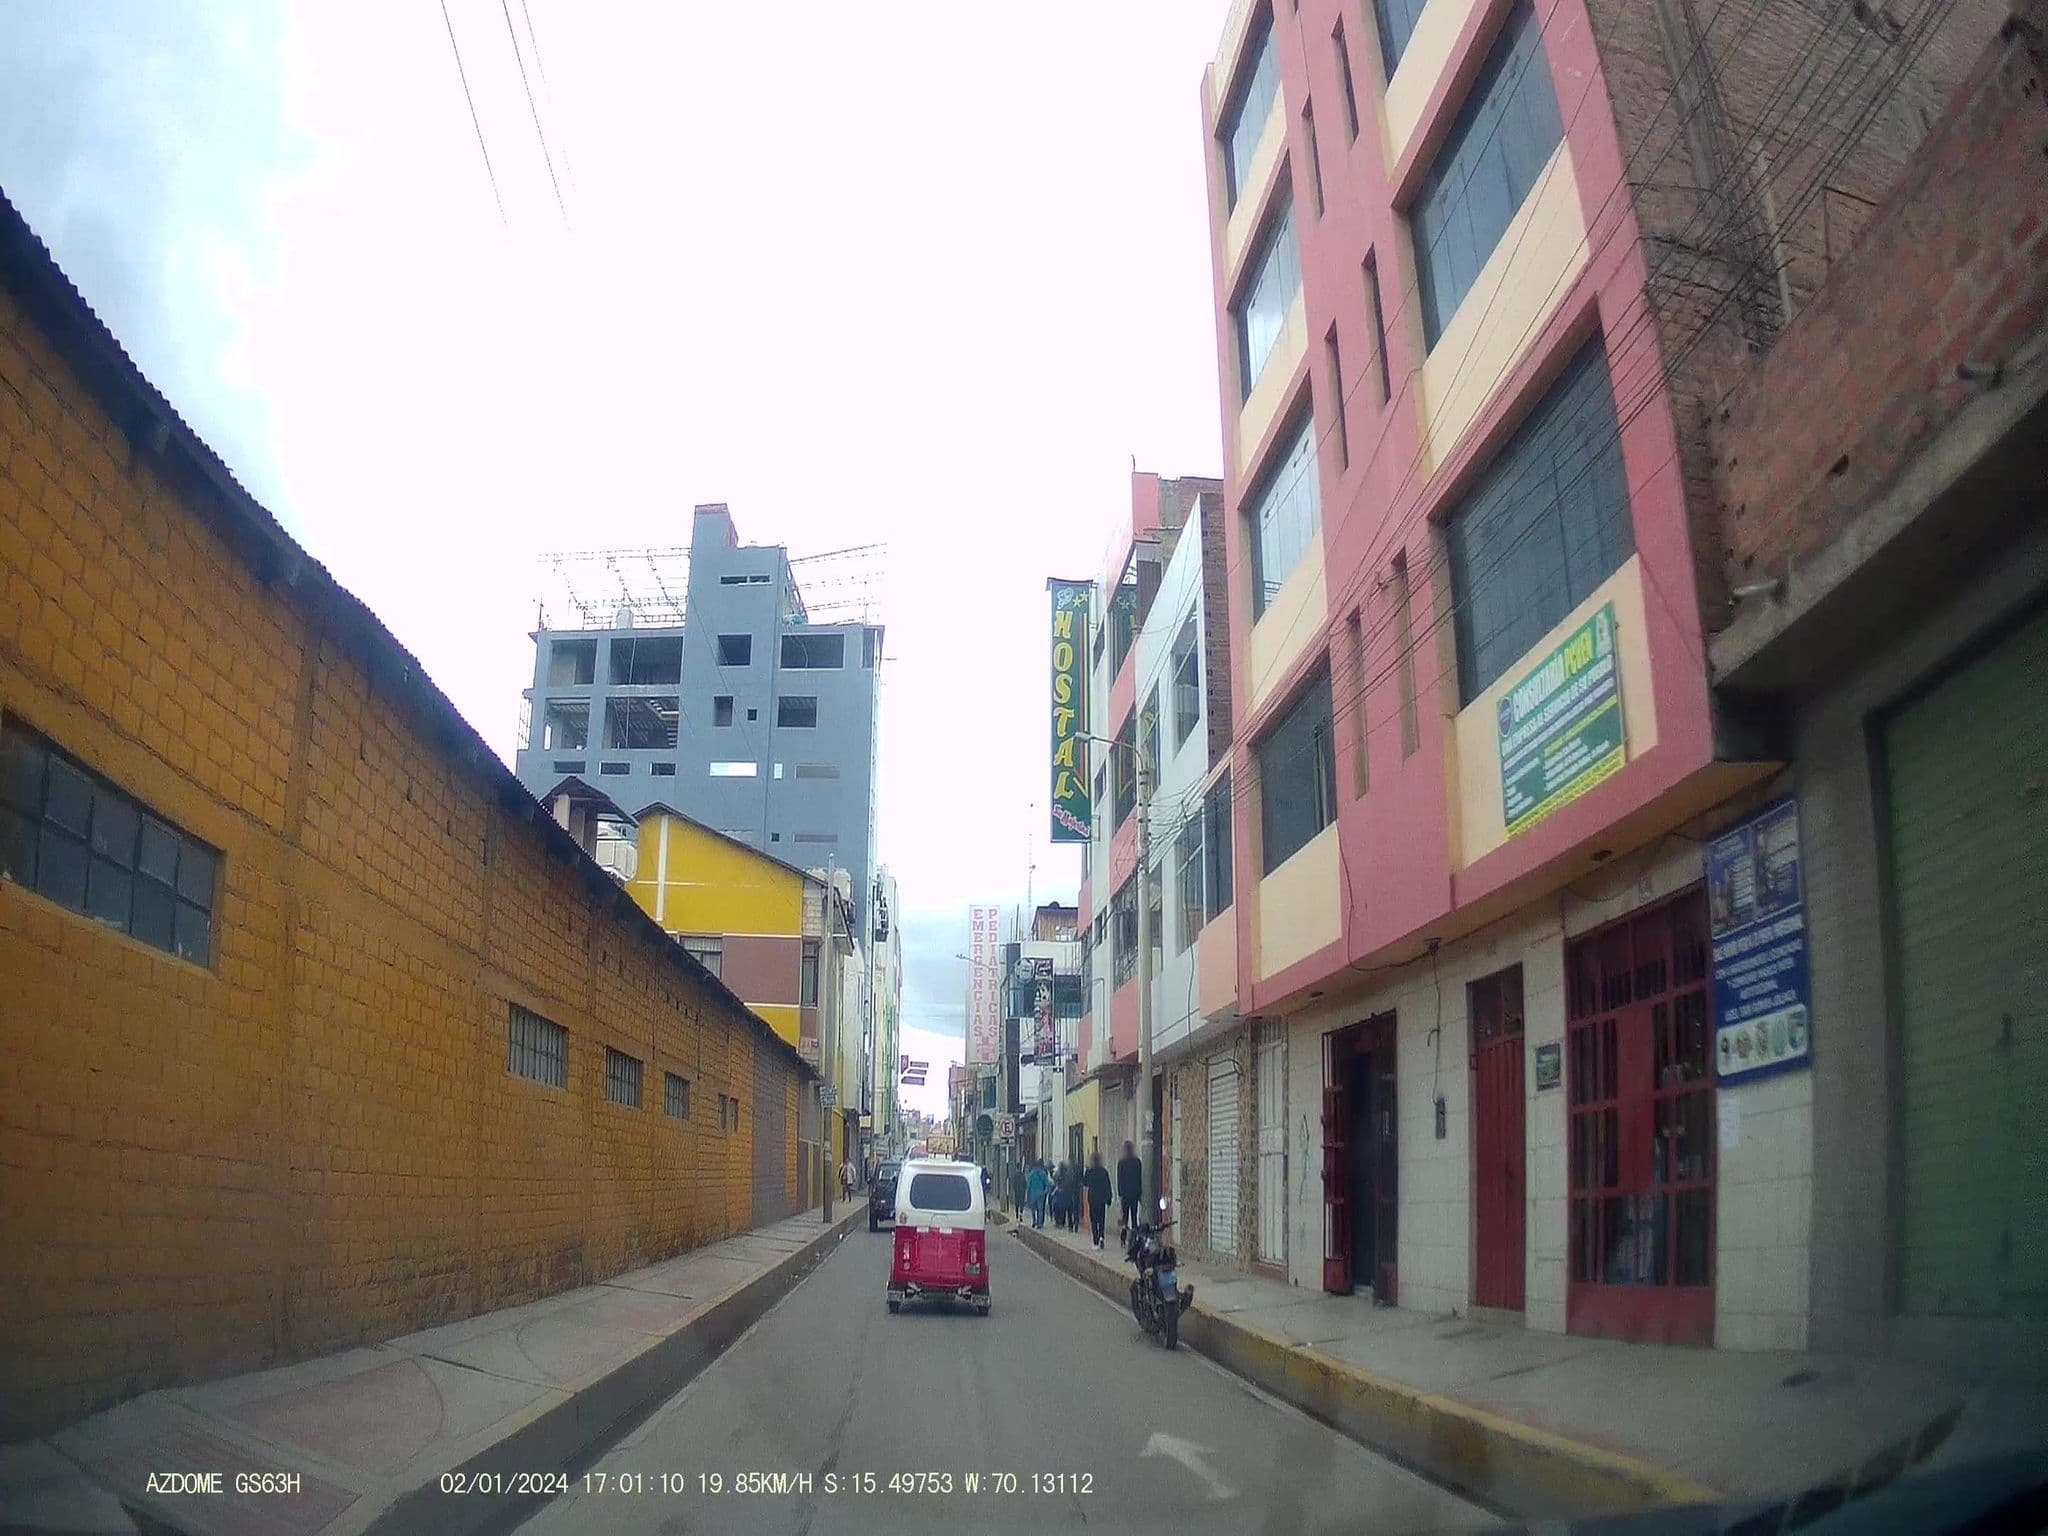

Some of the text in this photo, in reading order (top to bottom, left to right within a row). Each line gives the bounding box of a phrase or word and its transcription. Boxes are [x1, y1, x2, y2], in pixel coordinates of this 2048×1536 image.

[1054, 611, 1074, 800] HOSTAL
[973, 909, 984, 1037] EMERGENCIAS
[988, 909, 998, 1037] PEDIATRICAS
